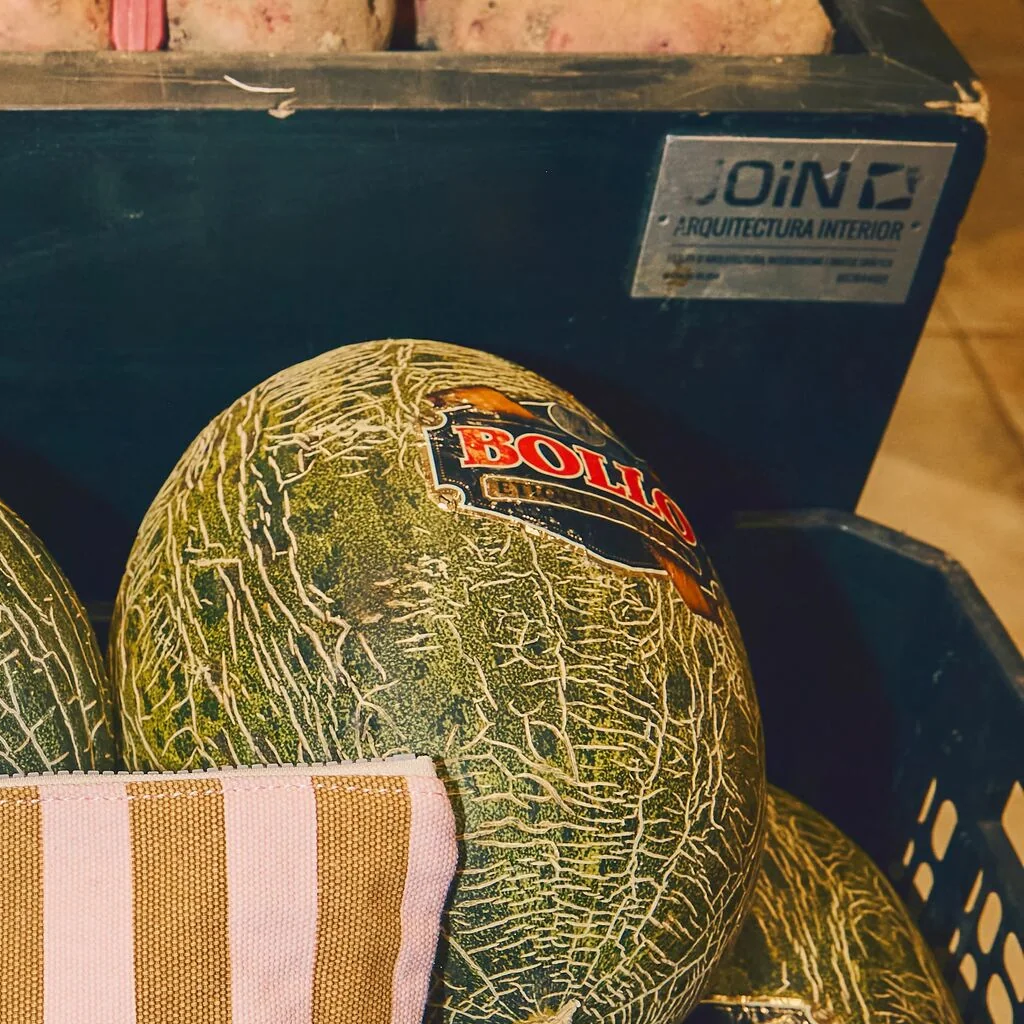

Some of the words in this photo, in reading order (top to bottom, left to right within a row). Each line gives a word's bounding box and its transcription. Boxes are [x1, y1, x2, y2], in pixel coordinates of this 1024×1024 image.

[673, 216, 813, 238] ARQUITECTURA
[817, 219, 904, 241] INTERIOR
[452, 425, 697, 546] BOLLO
